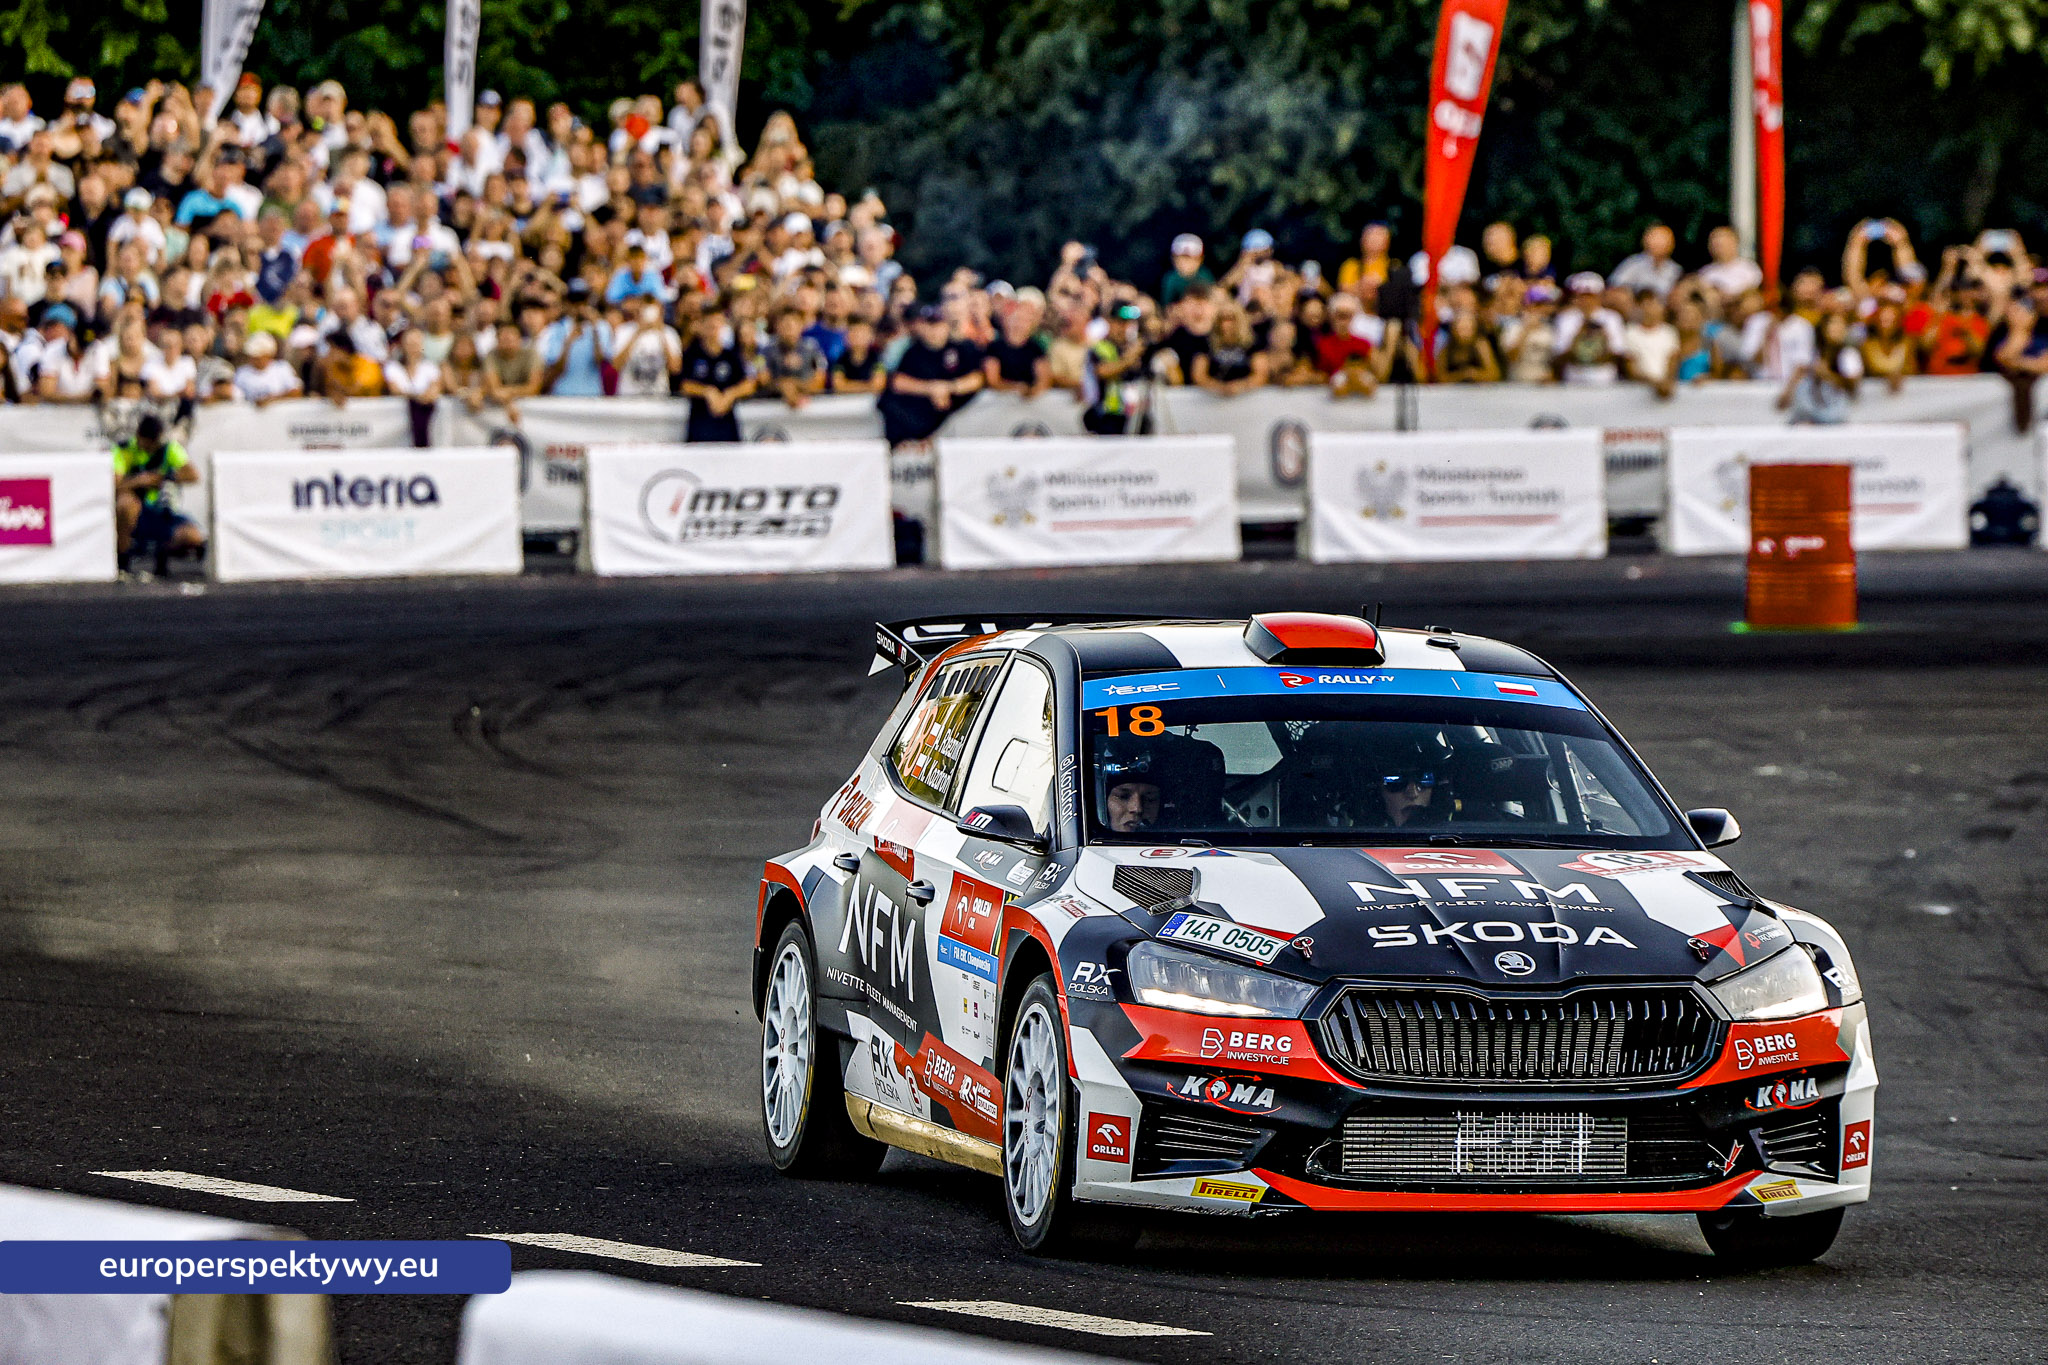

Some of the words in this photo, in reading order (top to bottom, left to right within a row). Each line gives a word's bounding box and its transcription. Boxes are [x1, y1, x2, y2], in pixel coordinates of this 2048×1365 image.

[293, 470, 441, 507] interia
[688, 484, 841, 514] MOTO
[1094, 705, 1166, 738] 18
[1346, 877, 1601, 905] NFM
[972, 897, 993, 918] ORLEN
[1355, 899, 1428, 912] NIVETTE
[1435, 900, 1488, 908] FLEET
[1494, 900, 1616, 913] MANAGEMENT
[837, 872, 917, 1003] NFM
[1161, 927, 1177, 936] CZ
[1181, 918, 1221, 942] 14R
[1222, 928, 1280, 956] 0505
[1366, 920, 1640, 950] SKODA
[1071, 961, 1123, 986] RX
[826, 966, 865, 993] NIVETTE
[866, 982, 882, 1004] FLEET
[882, 996, 918, 1033] MANAGEMENT
[1068, 982, 1109, 996] POLSKA
[1228, 1031, 1293, 1053] BERG
[1753, 1032, 1797, 1054] BERG
[1226, 1050, 1290, 1066] INWESTYCJE
[1758, 1052, 1800, 1066] INWESTYCJE
[933, 1054, 957, 1086] BERG
[1179, 1075, 1275, 1109] KOMA
[1757, 1078, 1820, 1108] KOMA
[1092, 1143, 1125, 1156] ORLEN
[1845, 1152, 1867, 1165] ORLEN
[1198, 1181, 1260, 1199] PIRELLI
[1758, 1183, 1799, 1201] PIRELLI
